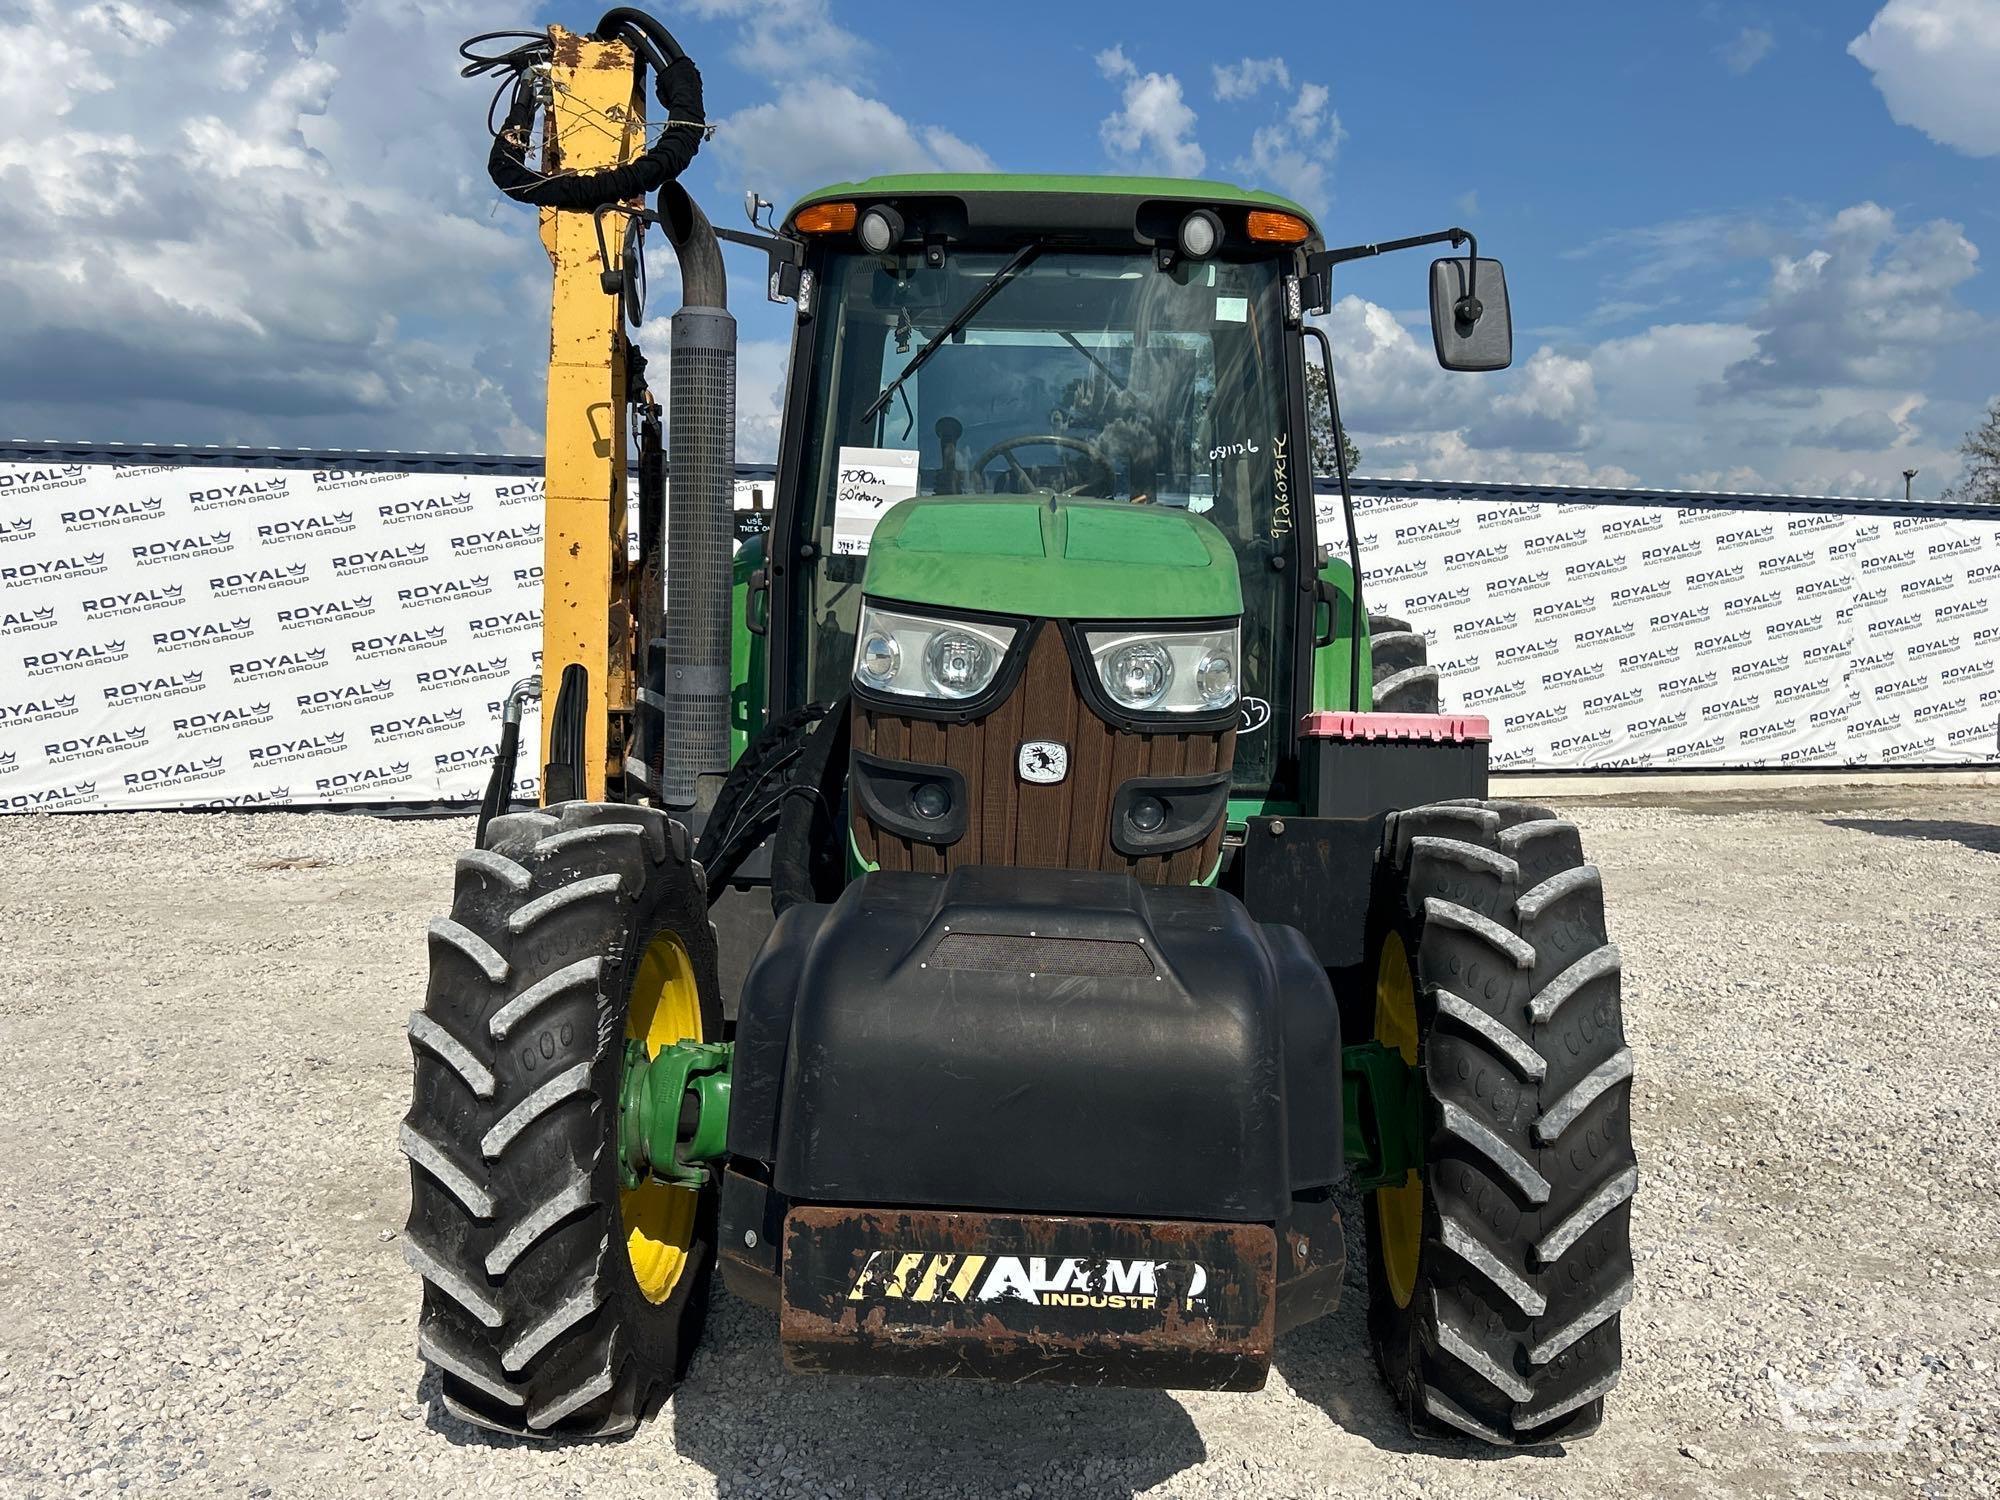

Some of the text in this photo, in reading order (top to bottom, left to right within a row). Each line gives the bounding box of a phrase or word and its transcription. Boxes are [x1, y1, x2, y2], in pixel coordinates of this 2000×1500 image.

[0, 469, 62, 487] OYAL
[1, 478, 87, 496] CTION GROUP
[317, 479, 368, 492] AUCTION
[370, 472, 410, 484] GROUP
[190, 482, 267, 503] ROYAL
[194, 488, 290, 512] AUCTION GROUP
[61, 503, 140, 524] ROYAL
[379, 497, 451, 517] ROYAL
[383, 504, 474, 526] AUCTION GROUP
[1477, 507, 1527, 523] ROYAL
[66, 508, 166, 533] AUCTION GROUP
[258, 516, 333, 537] ROYAL
[1396, 522, 1447, 538] ROYAL
[1479, 511, 1542, 530] AUCTION GROUP
[1602, 518, 1650, 534] ROYAL
[0, 532, 36, 543] ROUP
[262, 523, 356, 546] AUCTION GROUP
[451, 529, 521, 548] ROYAL
[1398, 526, 1462, 546] AUCTION GROUP
[1604, 523, 1663, 540] AUCTION GROUP
[1716, 530, 1761, 544] ROYAL
[132, 537, 211, 558] ROYAL
[455, 537, 544, 557] AUCTION GROUP
[1718, 534, 1774, 552] AUCTION GROUP
[137, 544, 234, 567] AUCTION GROUP
[332, 548, 406, 569] ROYAL
[1444, 548, 1494, 565] ROYAL
[1446, 553, 1509, 572] AUCTION GROUP
[2, 558, 82, 580] ROYAL
[6, 565, 108, 589] AUCTION GROUP
[336, 556, 429, 577] AUCTION GROUP
[210, 569, 286, 590] ROYAL
[214, 577, 310, 599] AUCTION GROUP
[1487, 576, 1536, 592] ROYAL
[1686, 570, 1732, 585] ROYAL
[1688, 576, 1745, 591] AUCTION GROUP
[1901, 579, 1942, 592] ROYAL
[82, 589, 163, 612] ROYAL
[398, 580, 469, 601] ROYAL
[402, 588, 492, 610] AUCTION GROUP
[1405, 592, 1456, 608] ROYAL
[1489, 582, 1550, 598] AUCTION GROUP
[1903, 584, 1954, 599] AUCTION GROUP
[87, 598, 186, 621] AUCTION GROUP
[278, 601, 352, 622] ROYAL
[1407, 598, 1471, 615] AUCTION GROUP
[1534, 601, 1582, 616] ROYAL
[1535, 607, 1596, 624] AUCTION GROUP
[14, 620, 58, 634] GROUP
[282, 609, 376, 631] AUCTION GROUP
[470, 611, 541, 631] ROYAL
[153, 623, 231, 645] ROYAL
[157, 631, 254, 654] AUCTION GROUP
[352, 632, 424, 652] ROYAL
[473, 626, 522, 640] AUCTION
[24, 644, 105, 668] ROYAL
[356, 639, 447, 661] AUCTION GROUP
[1496, 644, 1545, 660] ROYAL
[1498, 649, 1559, 666] AUCTION GROUP
[28, 654, 129, 677] AUCTION GROUP
[230, 654, 306, 676] ROYAL
[234, 661, 328, 684] AUCTION GROUP
[417, 664, 488, 684] ROYAL
[1732, 661, 1776, 675] ROYAL
[1734, 665, 1790, 682] AUCTION GROUP
[104, 677, 183, 699] ROYAL
[420, 670, 510, 692] AUCTION GROUP
[108, 684, 206, 708] AUCTION GROUP
[297, 685, 371, 706] ROYAL
[301, 692, 394, 715] AUCTION GROUP
[1463, 685, 1513, 702] ROYAL
[1465, 690, 1526, 708] AUCTION GROUP
[35, 708, 79, 721] GROUP
[174, 708, 250, 731] ROYAL
[1505, 711, 1554, 727] ROYAL
[1506, 716, 1568, 734] AUCTION GROUP
[177, 716, 274, 740] AUCTION GROUP
[370, 715, 442, 736] ROYAL
[374, 722, 466, 744] AUCTION GROUP
[45, 732, 126, 756] ROYAL
[49, 740, 149, 765] AUCTION GROUP
[249, 739, 324, 760] ROYAL
[253, 746, 348, 768] AUCTION GROUP
[437, 760, 487, 774] AUCTION
[124, 763, 202, 786] ROYAL
[128, 770, 226, 794] AUCTION GROUP
[316, 769, 390, 790] ROYAL
[320, 775, 412, 798] AUCTION GROUP
[56, 795, 100, 808] GROUP
